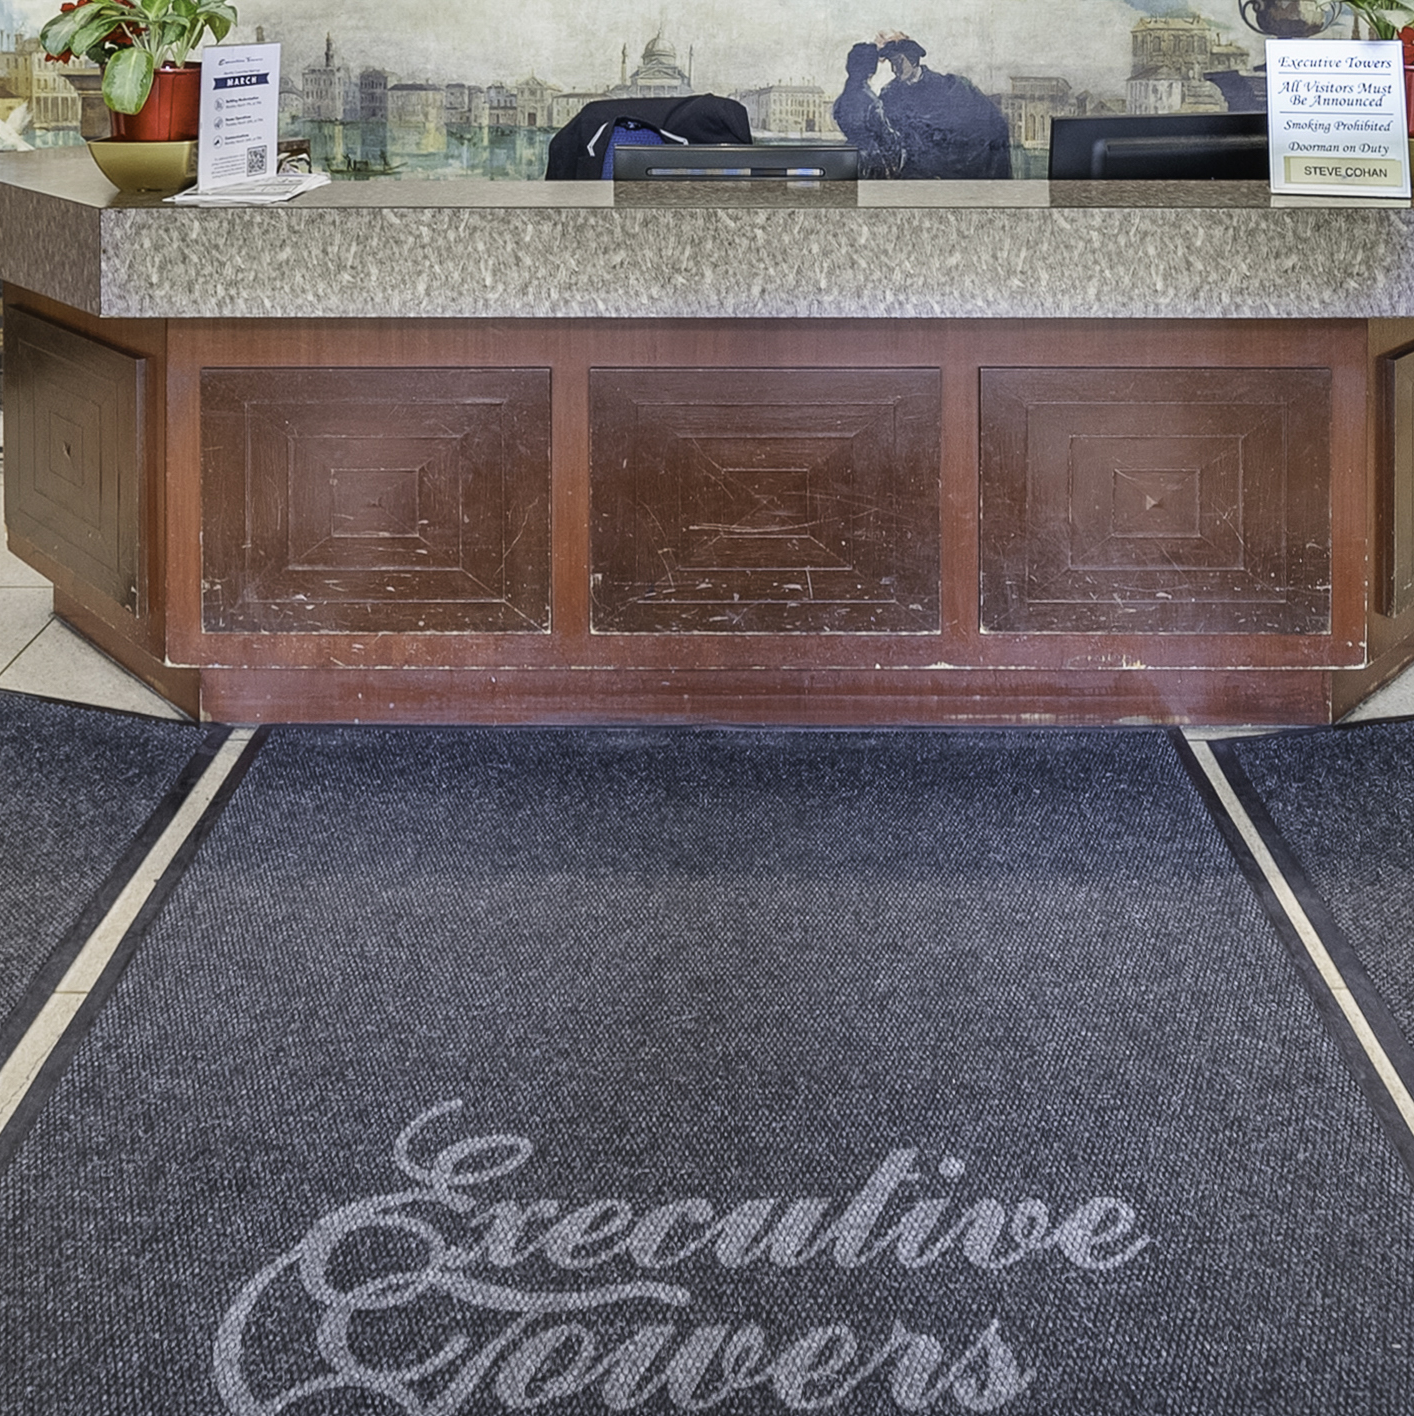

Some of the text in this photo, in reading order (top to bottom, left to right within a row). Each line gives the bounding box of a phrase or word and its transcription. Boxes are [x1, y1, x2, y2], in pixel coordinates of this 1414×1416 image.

[1278, 56, 1392, 70] Executive Towers
[226, 75, 258, 87] MARCH
[1278, 80, 1393, 97] All Visitors Must
[1289, 94, 1385, 109] Be Announced
[1283, 119, 1394, 133] Smoking Prohibited
[1288, 141, 1390, 157] Doorman on Duty
[1304, 166, 1388, 179] STEVE COHAN
[299, 1098, 1154, 1312] Executive
[213, 1248, 1038, 1416] Towers
